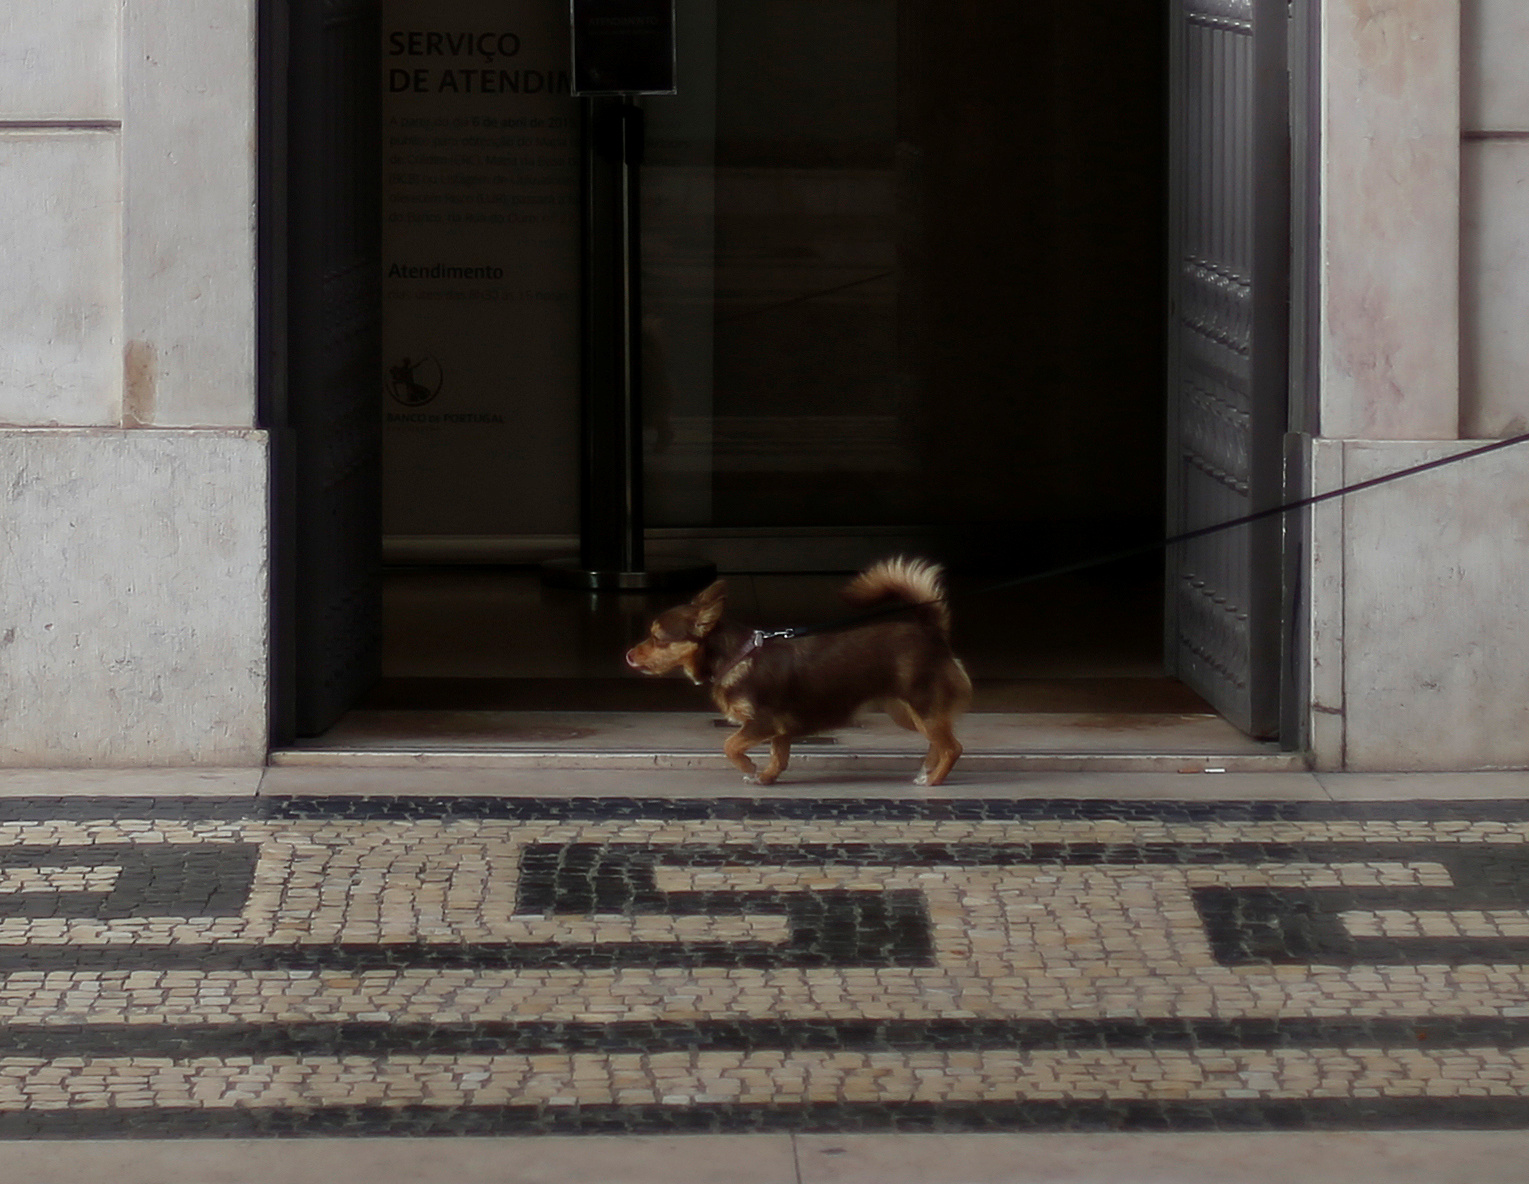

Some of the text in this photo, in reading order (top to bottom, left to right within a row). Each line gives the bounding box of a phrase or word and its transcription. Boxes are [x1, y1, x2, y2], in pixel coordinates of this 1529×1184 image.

[389, 31, 521, 63] SERVIÇO
[389, 69, 430, 94] DE
[387, 263, 504, 279] Atendimento
[387, 413, 426, 423] BANCO
[444, 413, 504, 424] PORTUGAL
